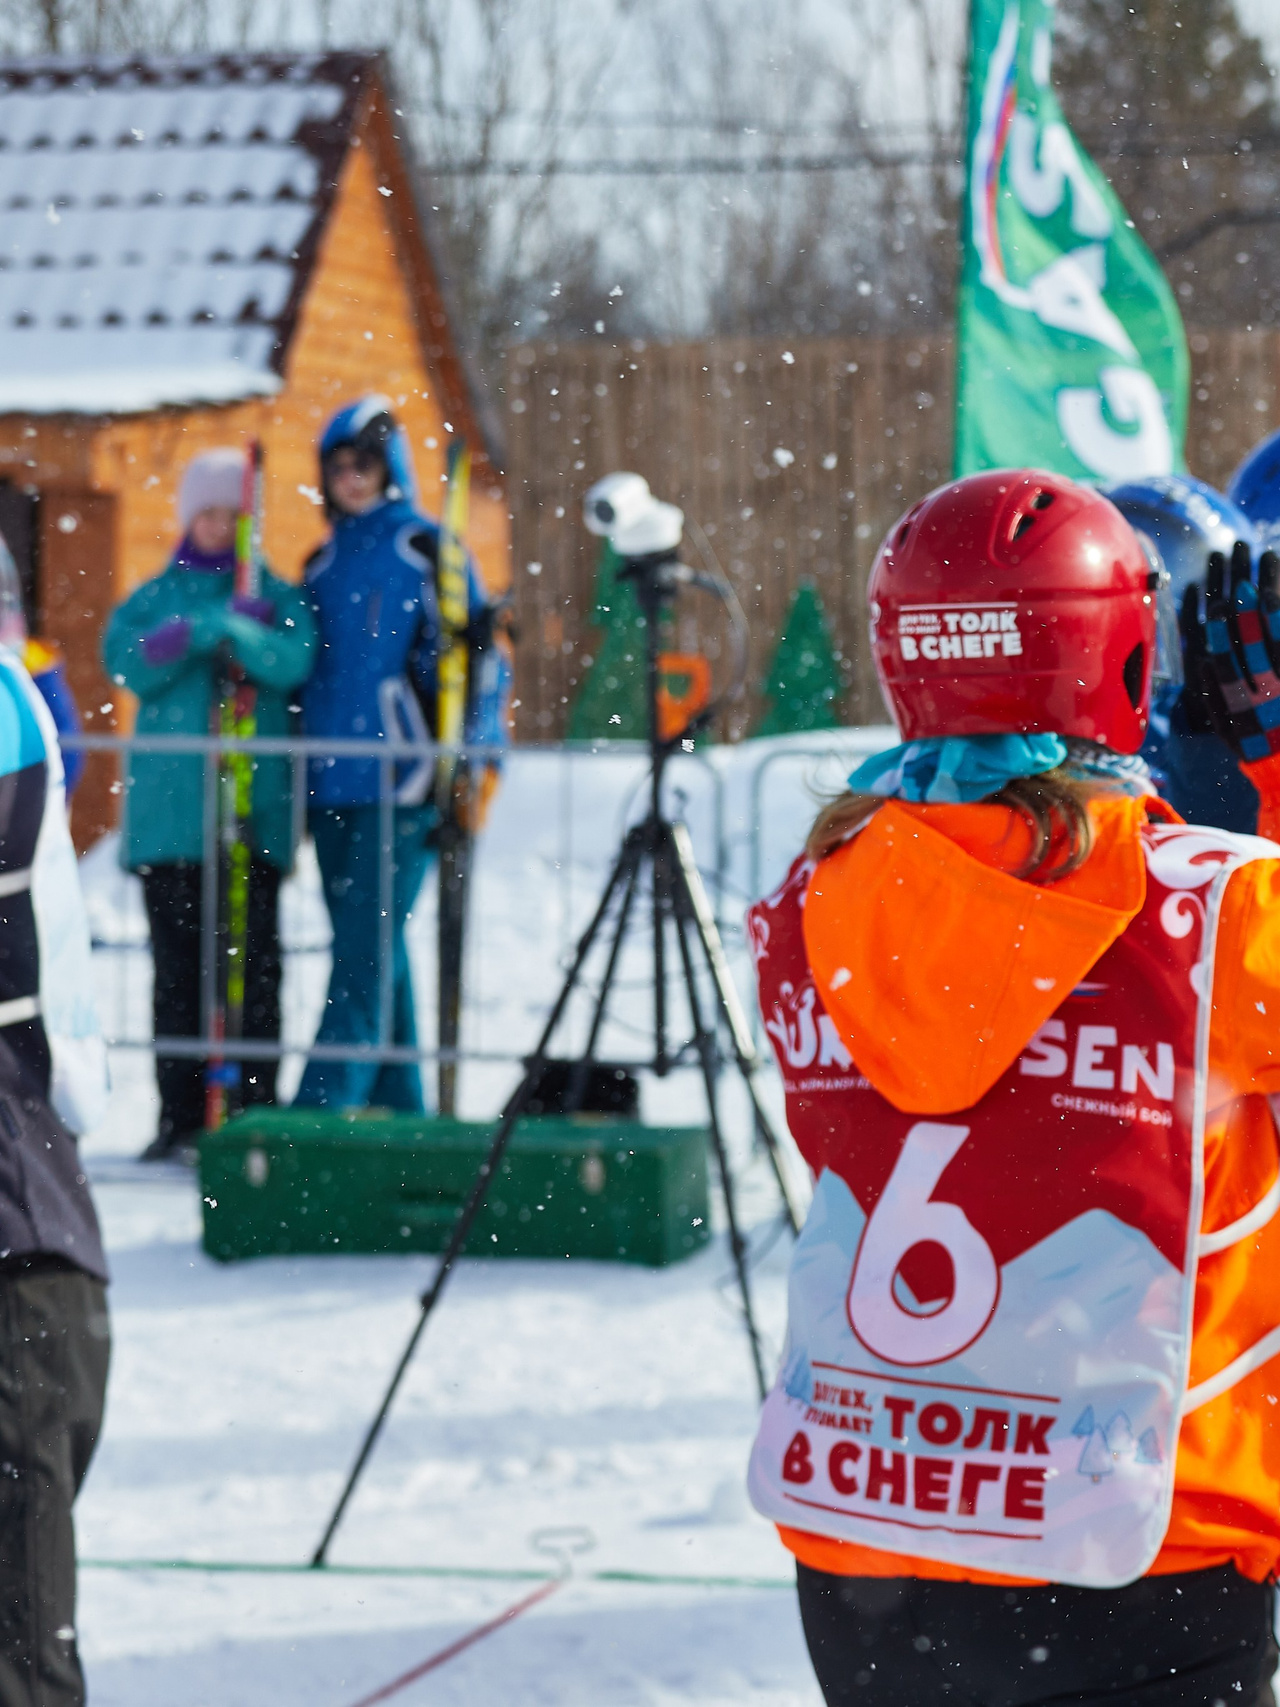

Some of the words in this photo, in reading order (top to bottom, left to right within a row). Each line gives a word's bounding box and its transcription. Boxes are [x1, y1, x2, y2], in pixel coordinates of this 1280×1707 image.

[901, 635, 919, 661] В
[920, 631, 1023, 660] СНЕГЕ
[943, 611, 1018, 634] ТОЛК
[1051, 1092, 1137, 1120] СНЕЖНЫЙ
[1138, 1106, 1173, 1128] БОЙ
[847, 1121, 1001, 1367] 6
[883, 1394, 1058, 1455] ТОЛК
[782, 1430, 815, 1485] В
[828, 1440, 1045, 1521] СНЕГЕ
